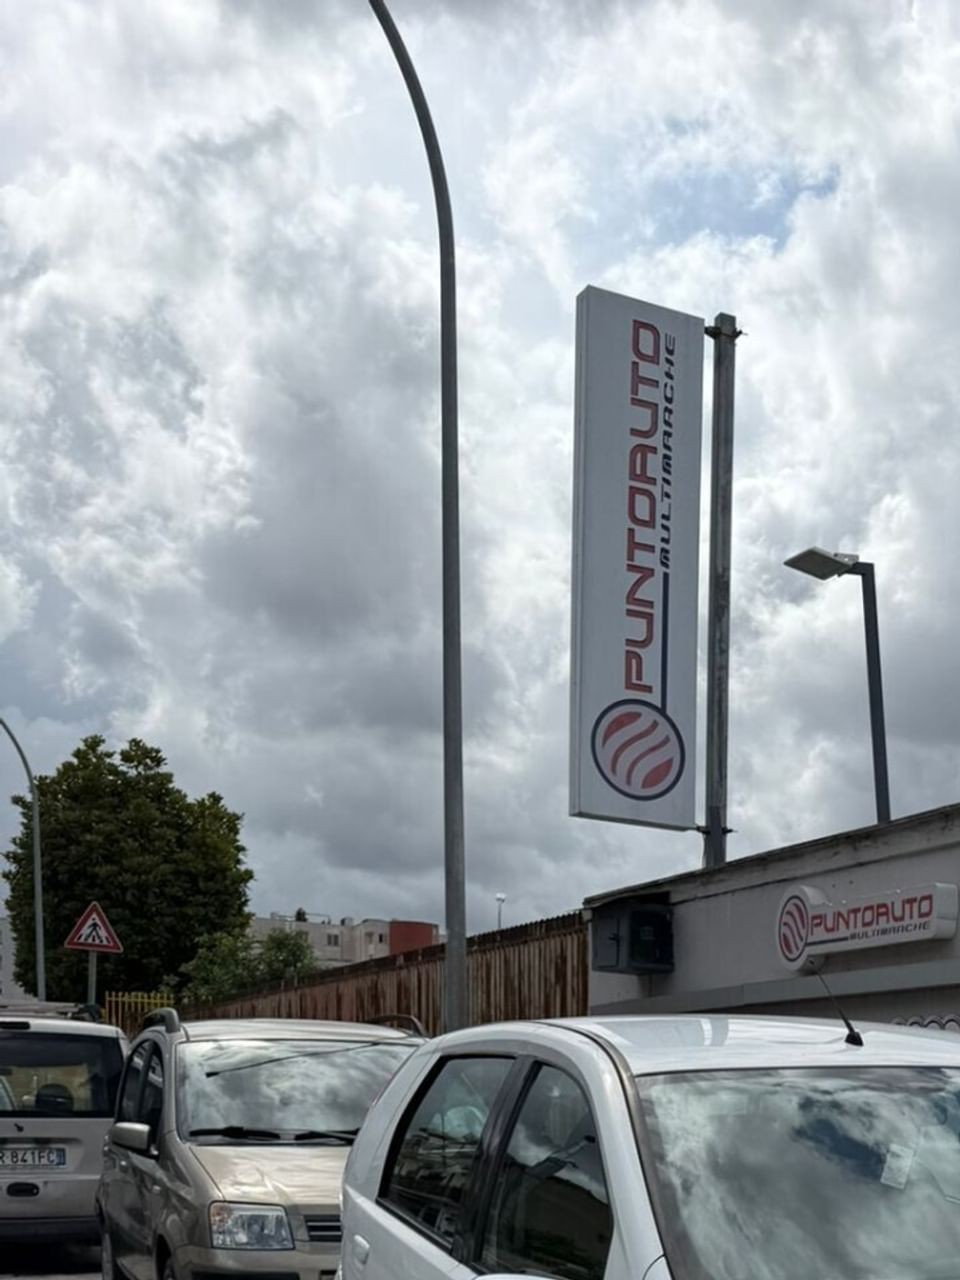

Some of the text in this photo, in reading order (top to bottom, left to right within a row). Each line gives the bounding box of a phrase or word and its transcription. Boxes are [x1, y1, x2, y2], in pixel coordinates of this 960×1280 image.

[624, 319, 662, 694] PUNTOAUTO
[660, 332, 676, 570] MULTIMARCHE
[810, 894, 933, 937] PUNTOAUTO
